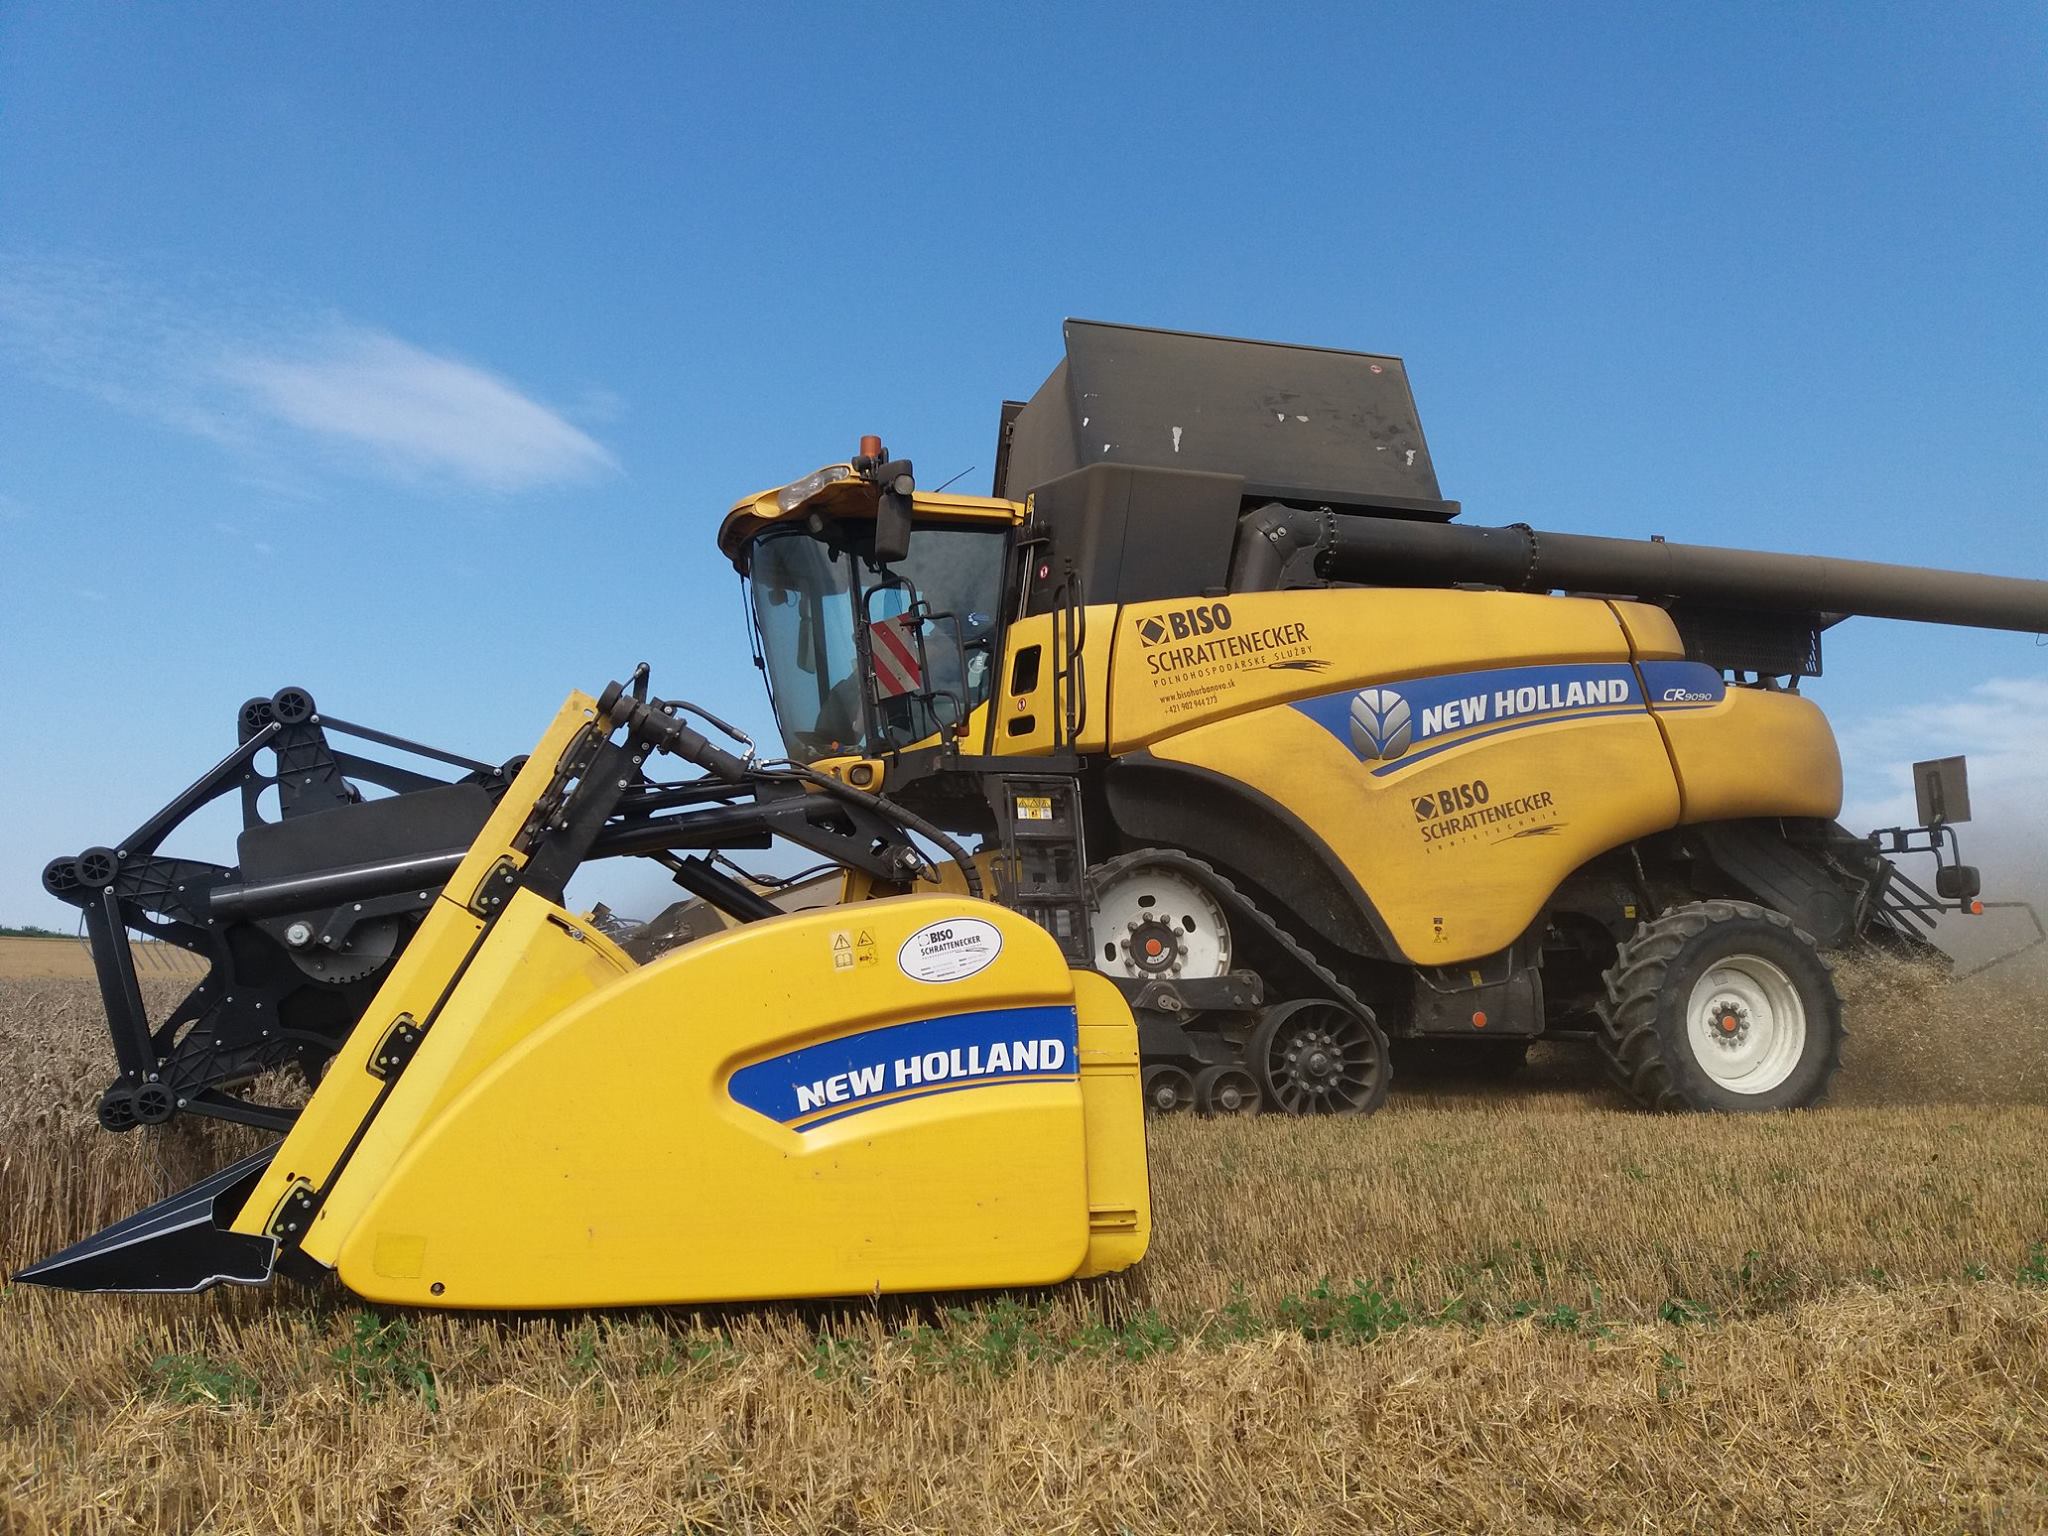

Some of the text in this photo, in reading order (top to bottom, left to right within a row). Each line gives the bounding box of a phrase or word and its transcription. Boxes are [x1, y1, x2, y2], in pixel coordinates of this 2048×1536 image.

[1168, 603, 1232, 640] BISO
[1147, 622, 1309, 675] SCHRATTENECKER
[1422, 679, 1629, 737] NEW HOLLAND
[1663, 688, 1712, 701] CR9090
[1438, 780, 1489, 815] BISO
[1421, 791, 1554, 842] SCHRATTENECKER
[921, 935, 981, 956] SCHRATTENECKER
[930, 928, 953, 944] BISO
[797, 1039, 1065, 1112] NEW HOLLAND
